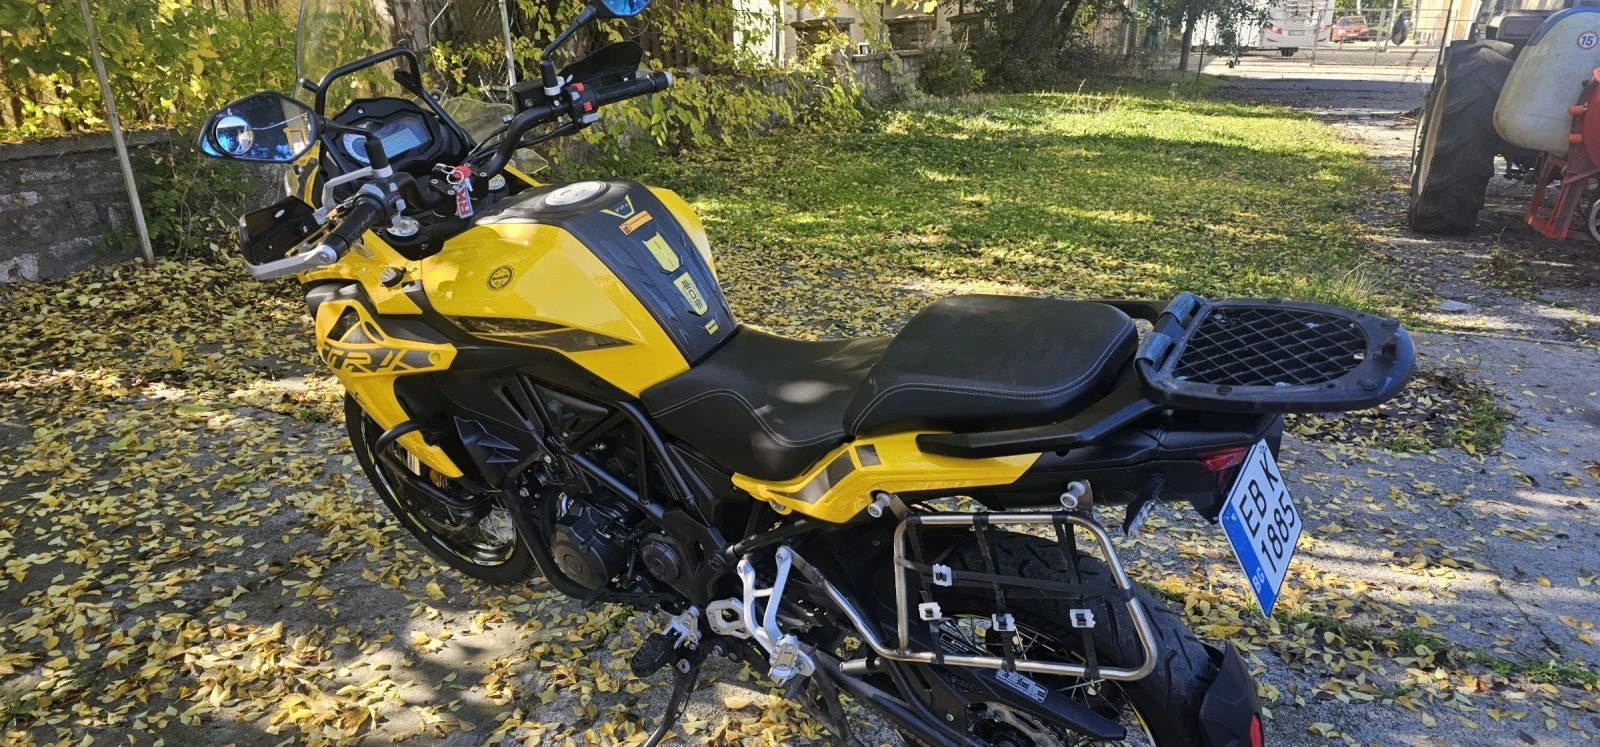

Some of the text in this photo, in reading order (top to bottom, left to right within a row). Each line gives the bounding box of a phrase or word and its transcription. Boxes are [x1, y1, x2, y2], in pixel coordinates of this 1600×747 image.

[1581, 35, 1595, 46] 15
[1239, 452, 1279, 539] EB K
[1261, 491, 1295, 573] 1885
[1252, 566, 1265, 594] BG
